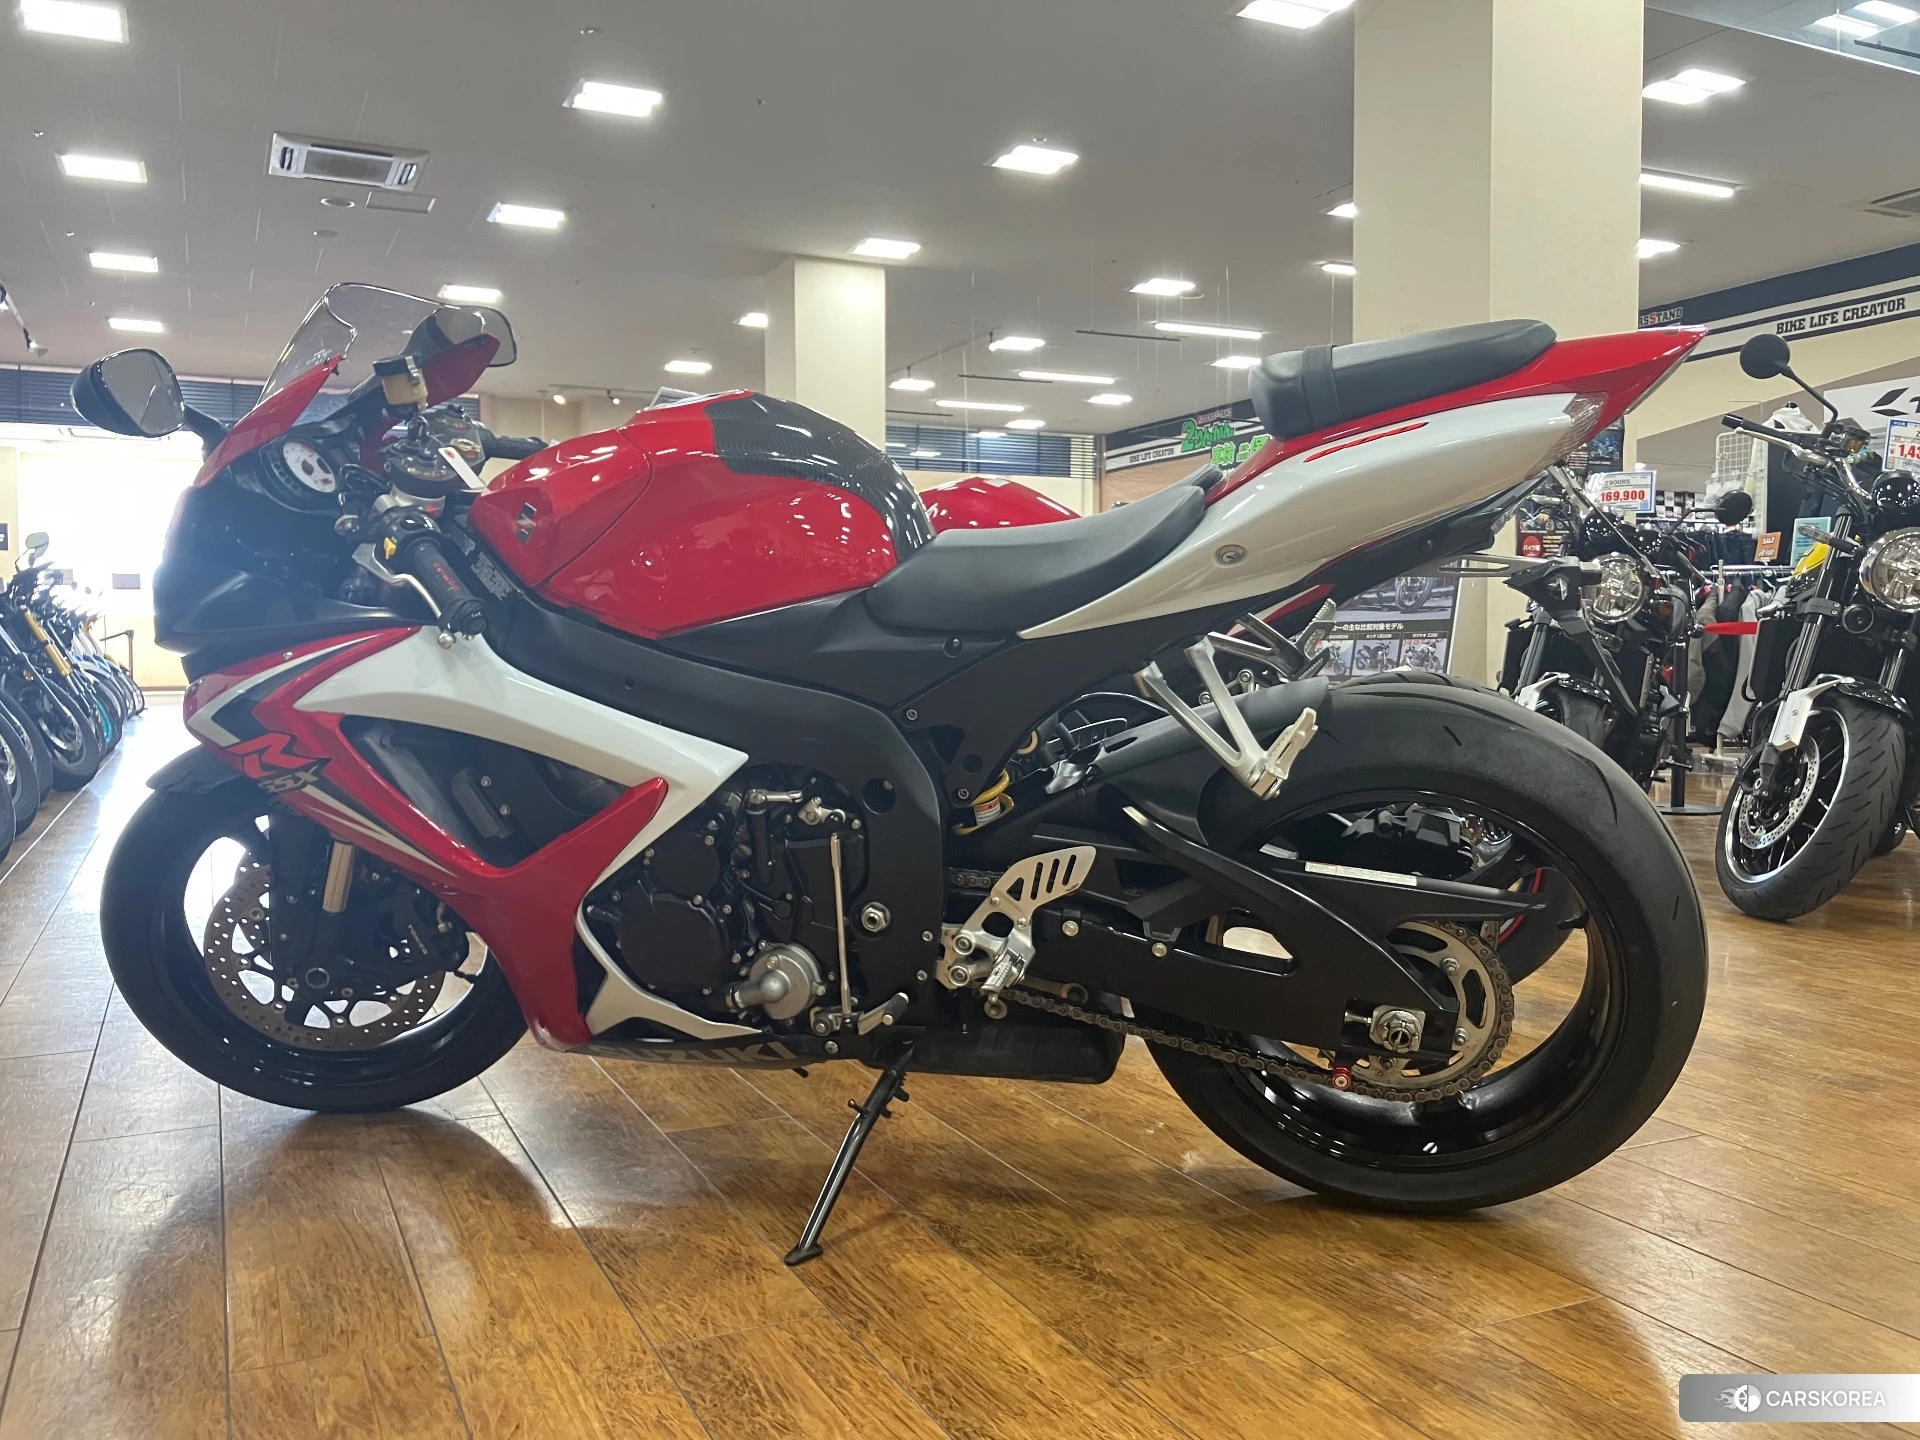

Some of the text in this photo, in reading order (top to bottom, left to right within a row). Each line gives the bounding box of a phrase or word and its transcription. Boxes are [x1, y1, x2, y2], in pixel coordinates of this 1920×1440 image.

[1776, 297, 1906, 335] BIKE LIFE CREATOR
[588, 1040, 797, 1063] SUZUKI
